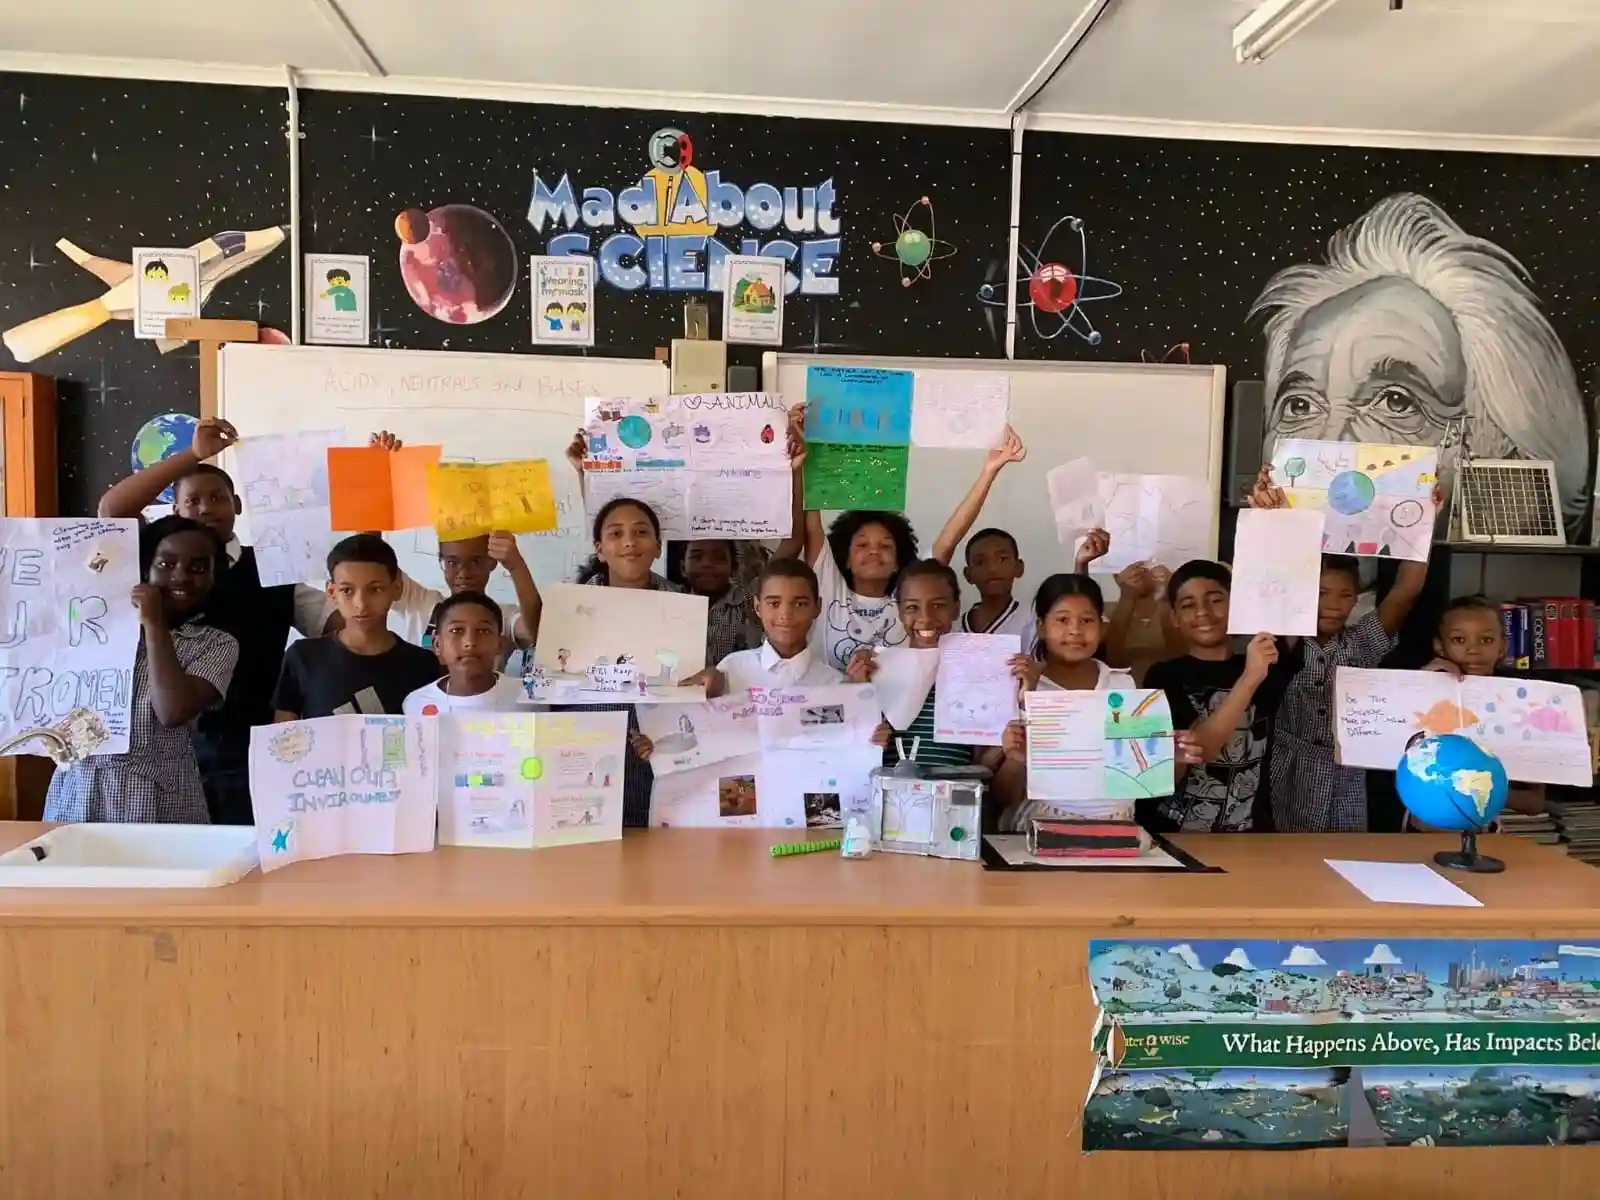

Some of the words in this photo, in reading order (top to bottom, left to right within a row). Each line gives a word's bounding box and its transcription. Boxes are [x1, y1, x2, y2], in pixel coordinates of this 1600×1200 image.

[527, 169, 657, 234] Mad
[668, 169, 841, 235] About
[1533, 618, 1545, 660] CONCISE
[292, 765, 346, 788] CLEAN
[350, 766, 397, 788] OUR
[1222, 1033, 1281, 1054] What
[1286, 1034, 1367, 1059] Happens
[1371, 1031, 1440, 1055] Above,
[1445, 1033, 1481, 1051] Has
[1486, 1032, 1563, 1056] Impacts
